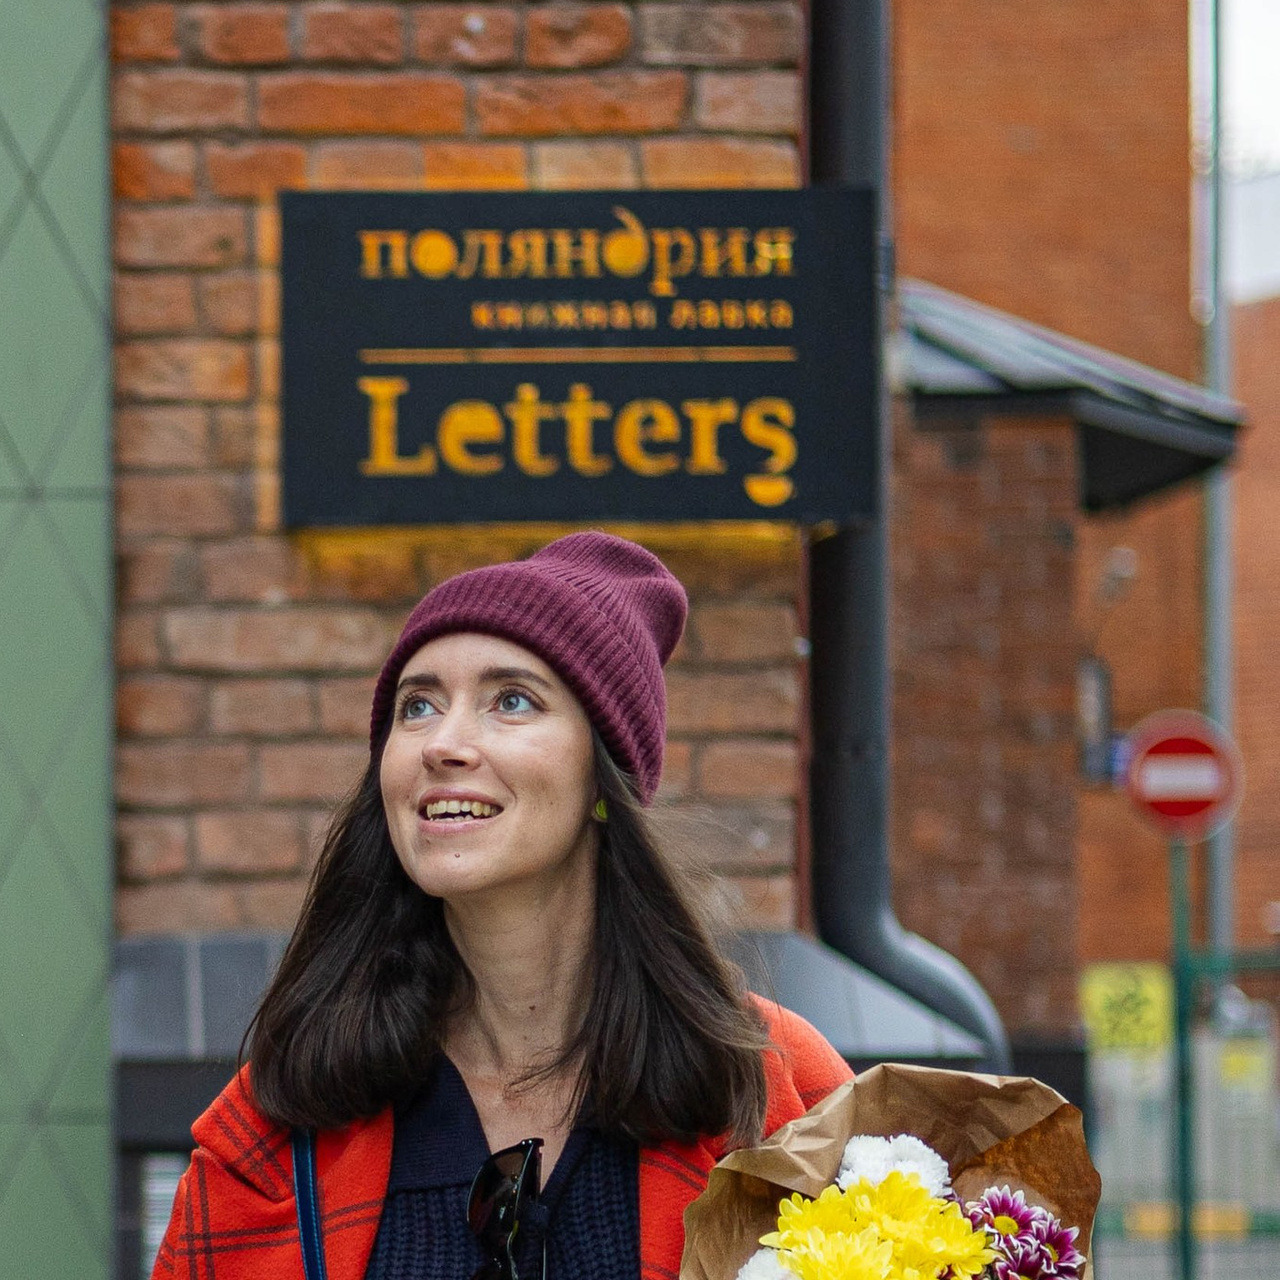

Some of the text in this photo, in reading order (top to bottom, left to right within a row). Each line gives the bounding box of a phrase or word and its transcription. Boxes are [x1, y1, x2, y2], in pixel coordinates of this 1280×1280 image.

[358, 206, 795, 296] поляндрия
[670, 299, 793, 329] лавка
[357, 376, 797, 506] Letters
